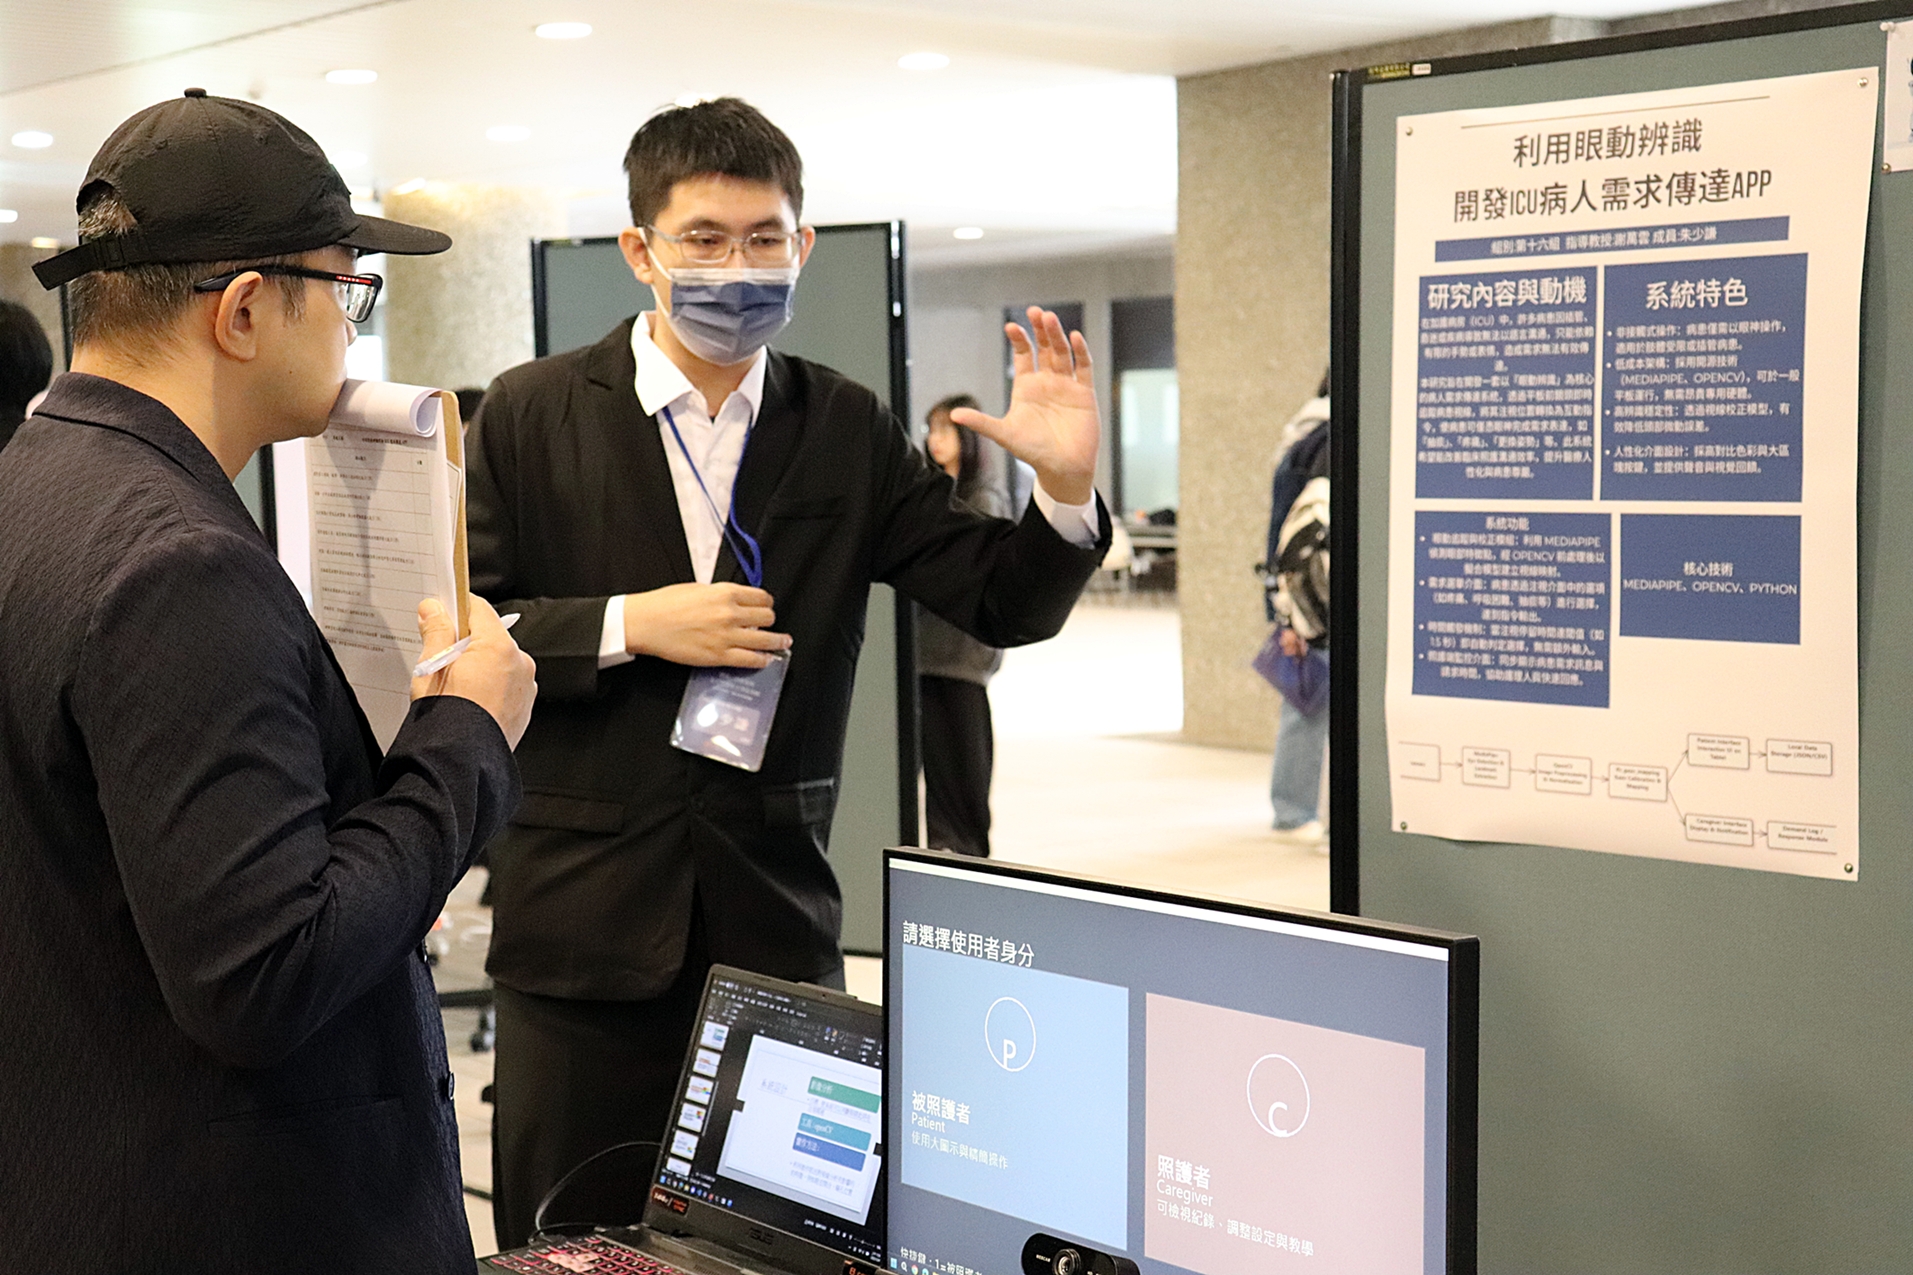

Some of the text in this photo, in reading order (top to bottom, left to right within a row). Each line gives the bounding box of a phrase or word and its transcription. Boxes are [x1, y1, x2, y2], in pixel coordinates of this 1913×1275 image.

[1513, 118, 1704, 168] 利用眼動辨識
[1454, 168, 1773, 223] 開發ICU病人需求傳達APP
[1427, 276, 1588, 310] 研究內容與動機
[1645, 277, 1749, 311] 系統特色
[1512, 550, 1555, 562] OPENCV
[1544, 535, 1602, 548] MEDIAPIPE
[1683, 561, 1734, 578] 核心技術
[902, 919, 1035, 968] 請選擇使用者身分
[1002, 1038, 1017, 1069] P
[911, 1090, 971, 1126] 被照護者
[911, 1112, 947, 1134] Patient
[1267, 1101, 1289, 1137] C
[911, 1130, 1009, 1171] 使用大圖示與精簡操作
[1157, 1153, 1211, 1190] 照護者
[1156, 1180, 1214, 1208] Caregiver
[1156, 1199, 1315, 1257] 可檢視紀錄、調整設定與教學
